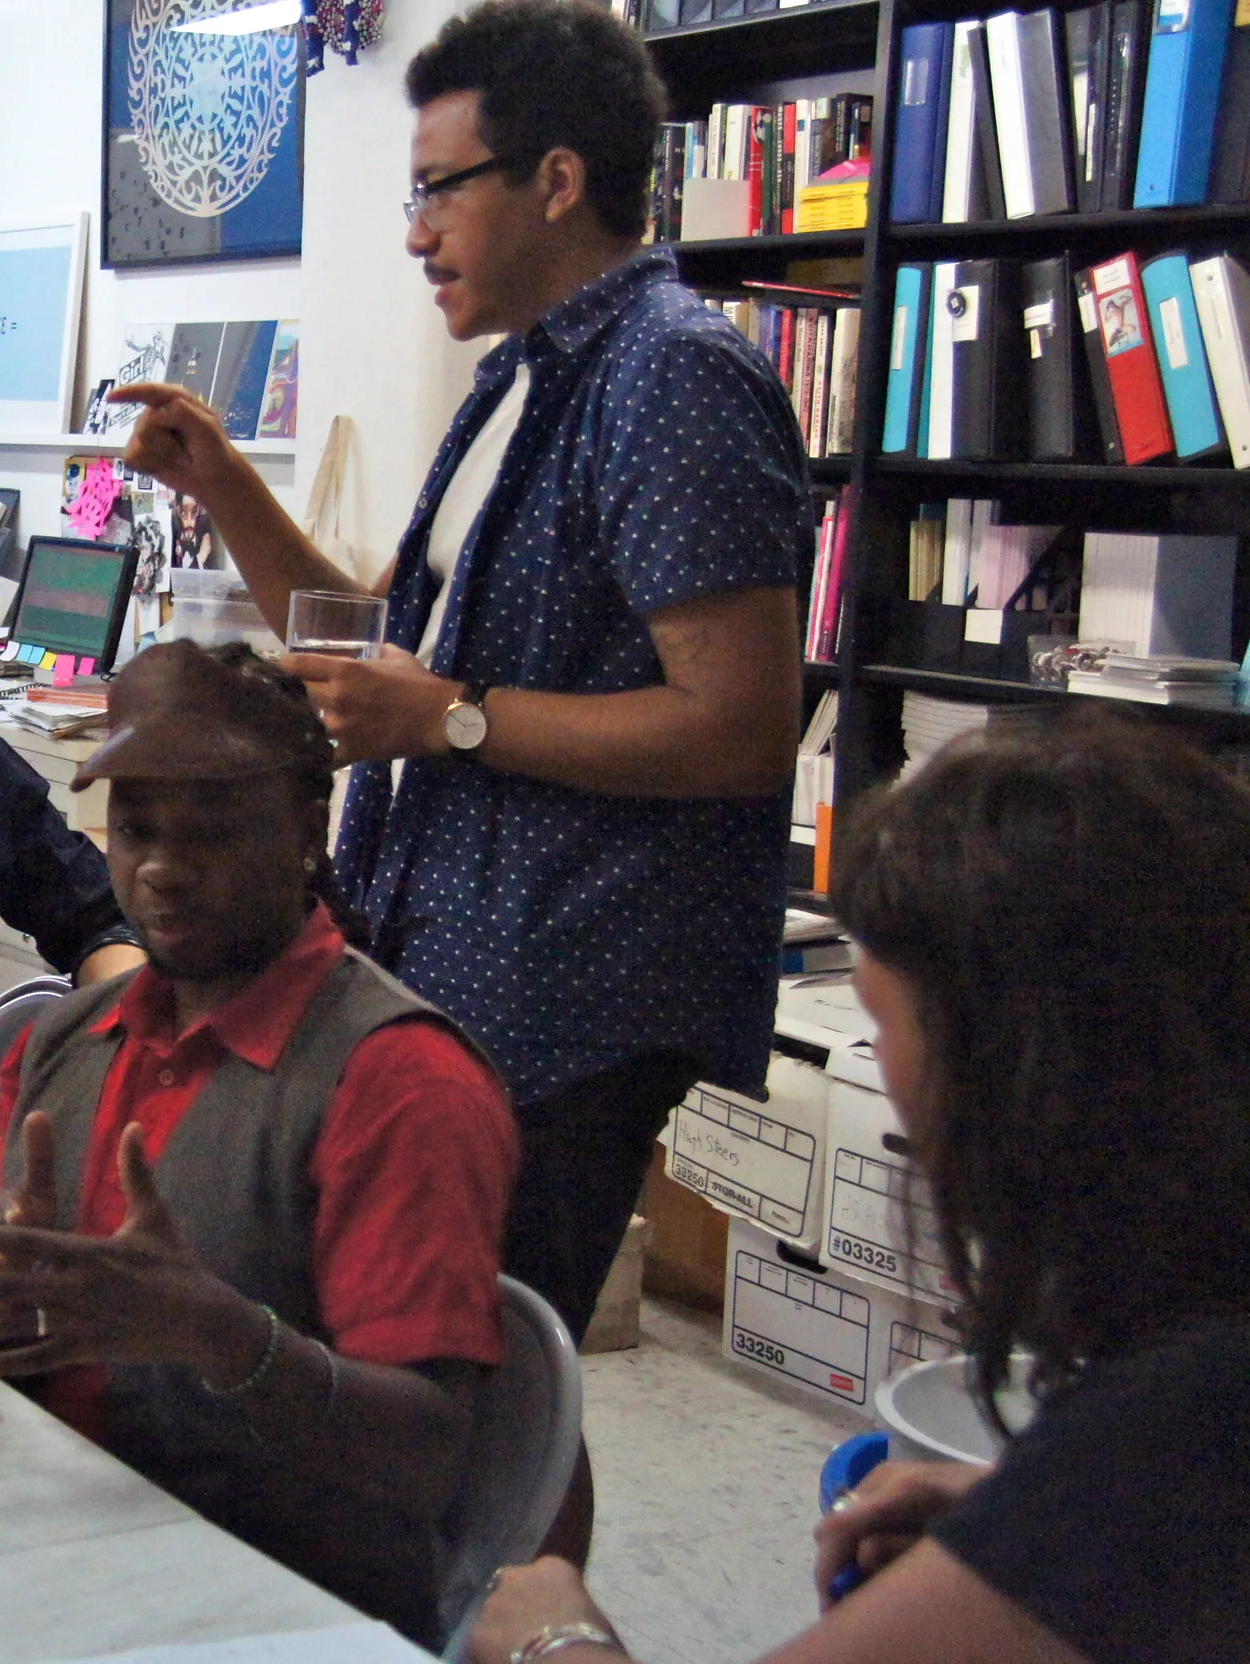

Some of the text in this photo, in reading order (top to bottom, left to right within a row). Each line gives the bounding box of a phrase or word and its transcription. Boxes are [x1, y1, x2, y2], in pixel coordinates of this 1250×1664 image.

[120, 353, 145, 386] Girl
[675, 1163, 754, 1209] 33250 STOR-ALL
[833, 1235, 898, 1273] #03325
[735, 1333, 785, 1365] 33250
